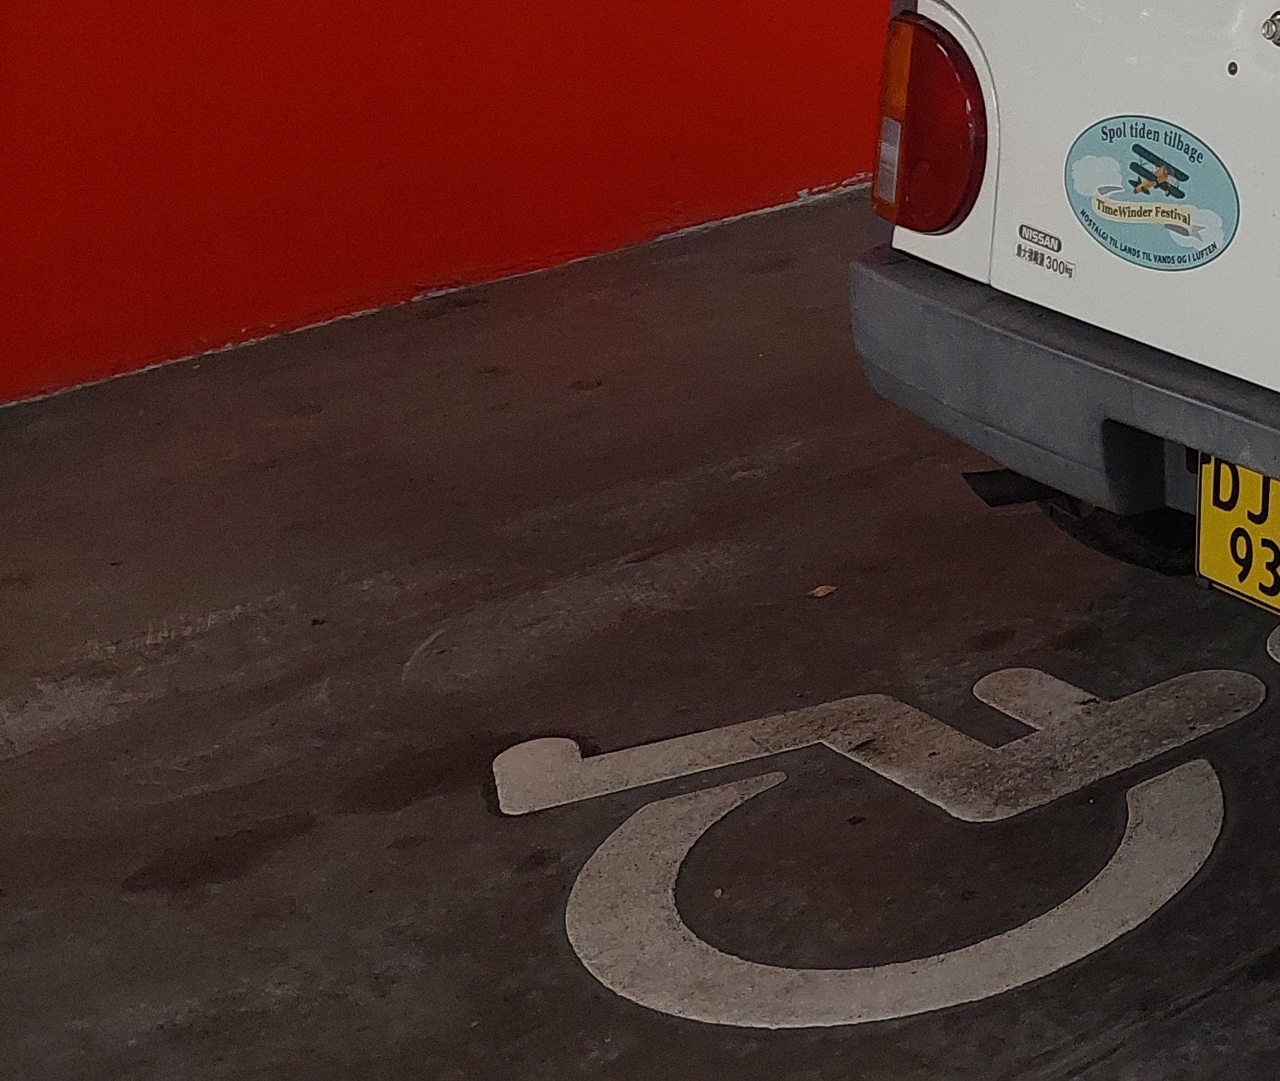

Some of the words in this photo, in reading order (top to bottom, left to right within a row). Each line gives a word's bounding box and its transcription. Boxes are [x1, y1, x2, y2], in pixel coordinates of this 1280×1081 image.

[1101, 122, 1126, 143] Spol
[1130, 122, 1160, 142] tiden
[1163, 130, 1204, 164] tilbage
[1096, 199, 1153, 218] TimeWinder
[1155, 206, 1191, 226] Festival
[1022, 226, 1059, 251] NISSAN
[1080, 209, 1108, 241] NOSTALGI
[1109, 236, 1119, 249] TIL
[1120, 244, 1140, 259] LANDS
[1142, 251, 1152, 262] TIL
[1153, 254, 1175, 265] VANDS
[1177, 254, 1187, 264] OG
[1192, 241, 1218, 262] LUFTEN
